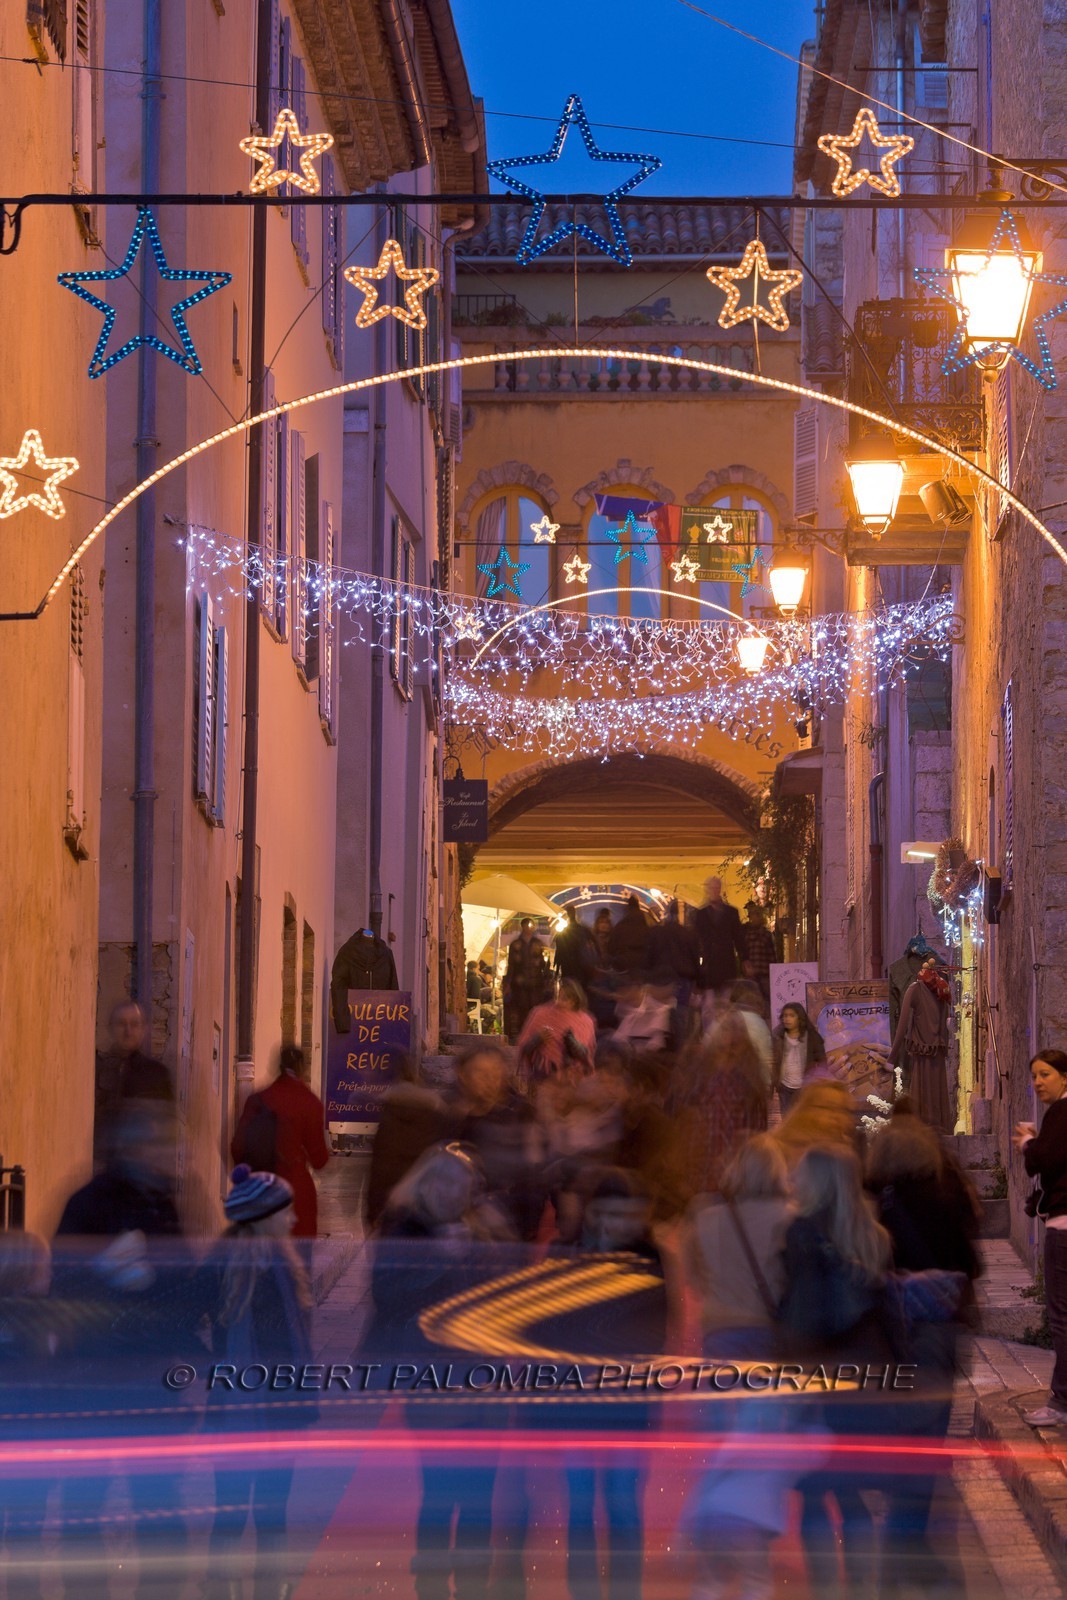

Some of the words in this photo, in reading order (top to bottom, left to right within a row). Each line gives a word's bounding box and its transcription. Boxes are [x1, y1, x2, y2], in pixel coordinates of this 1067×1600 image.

[443, 797, 486, 806] Restaurant
[827, 985, 881, 997] STAGE
[358, 1025, 380, 1042] DE
[328, 1101, 363, 1113] Espace
